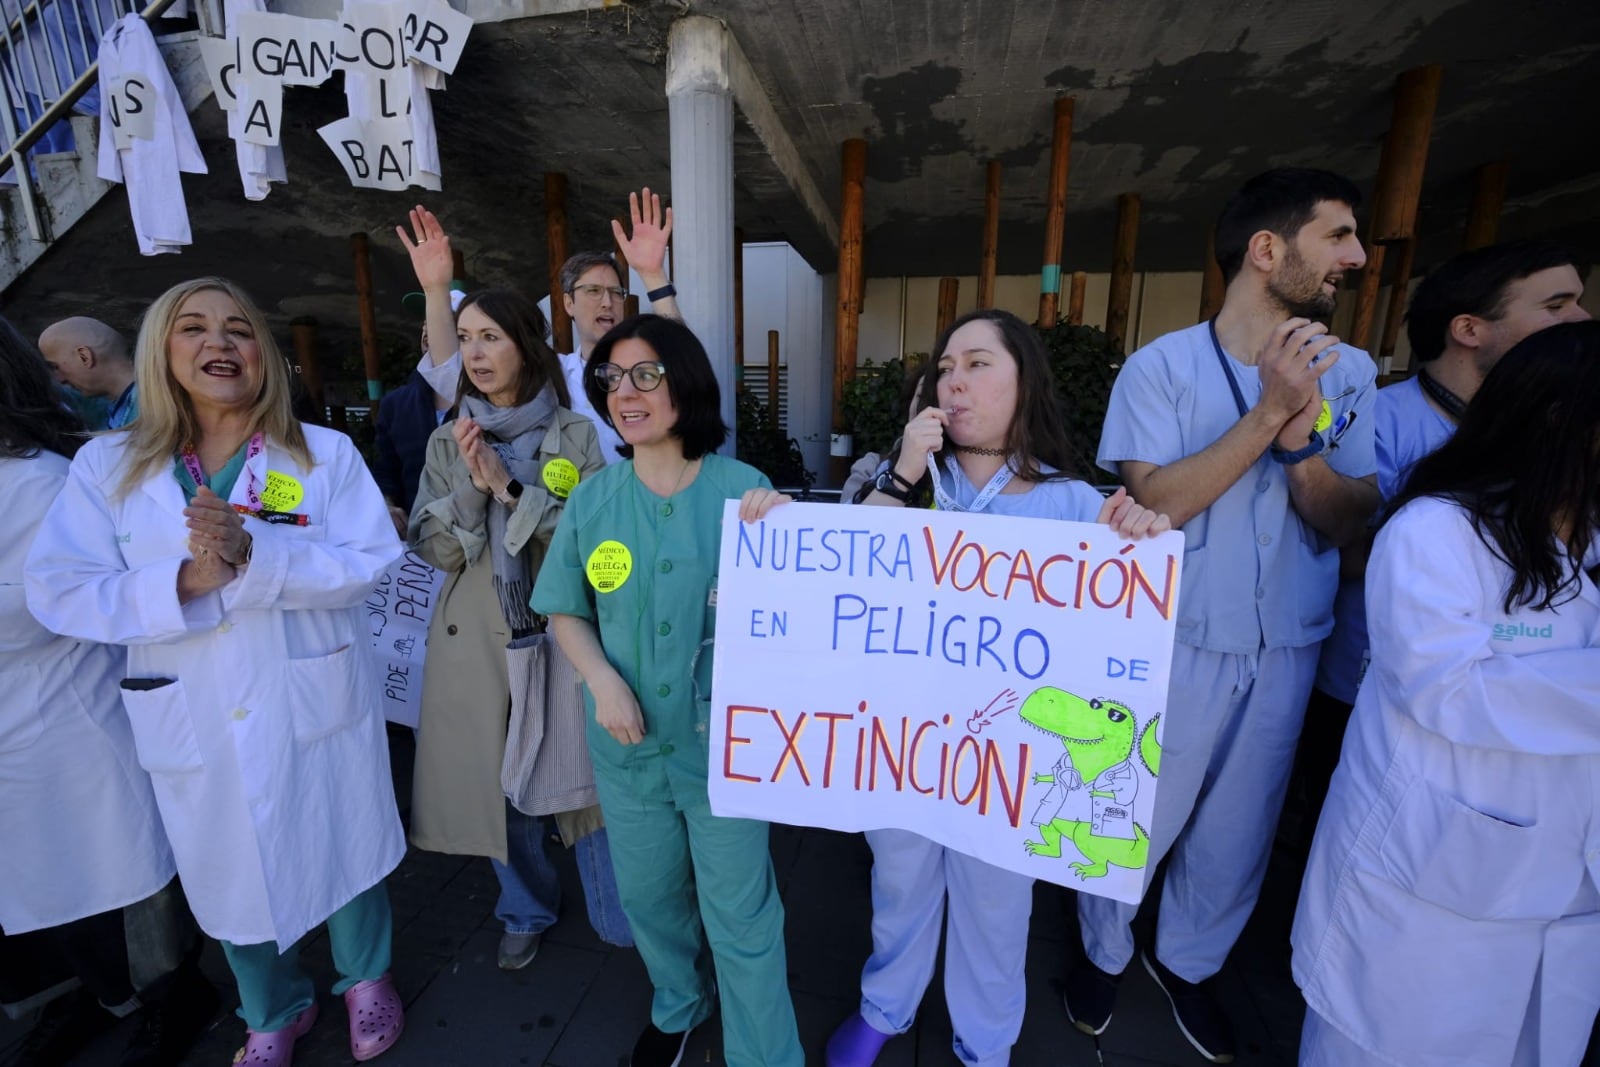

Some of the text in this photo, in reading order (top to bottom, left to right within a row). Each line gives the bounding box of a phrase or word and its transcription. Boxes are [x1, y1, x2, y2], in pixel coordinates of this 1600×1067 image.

[244, 99, 272, 137] A
[591, 561, 627, 570] HUELGA
[736, 520, 914, 582] NUESTRA
[750, 609, 788, 638] EN
[1106, 656, 1150, 682] DE
[1493, 622, 1553, 639] salud
